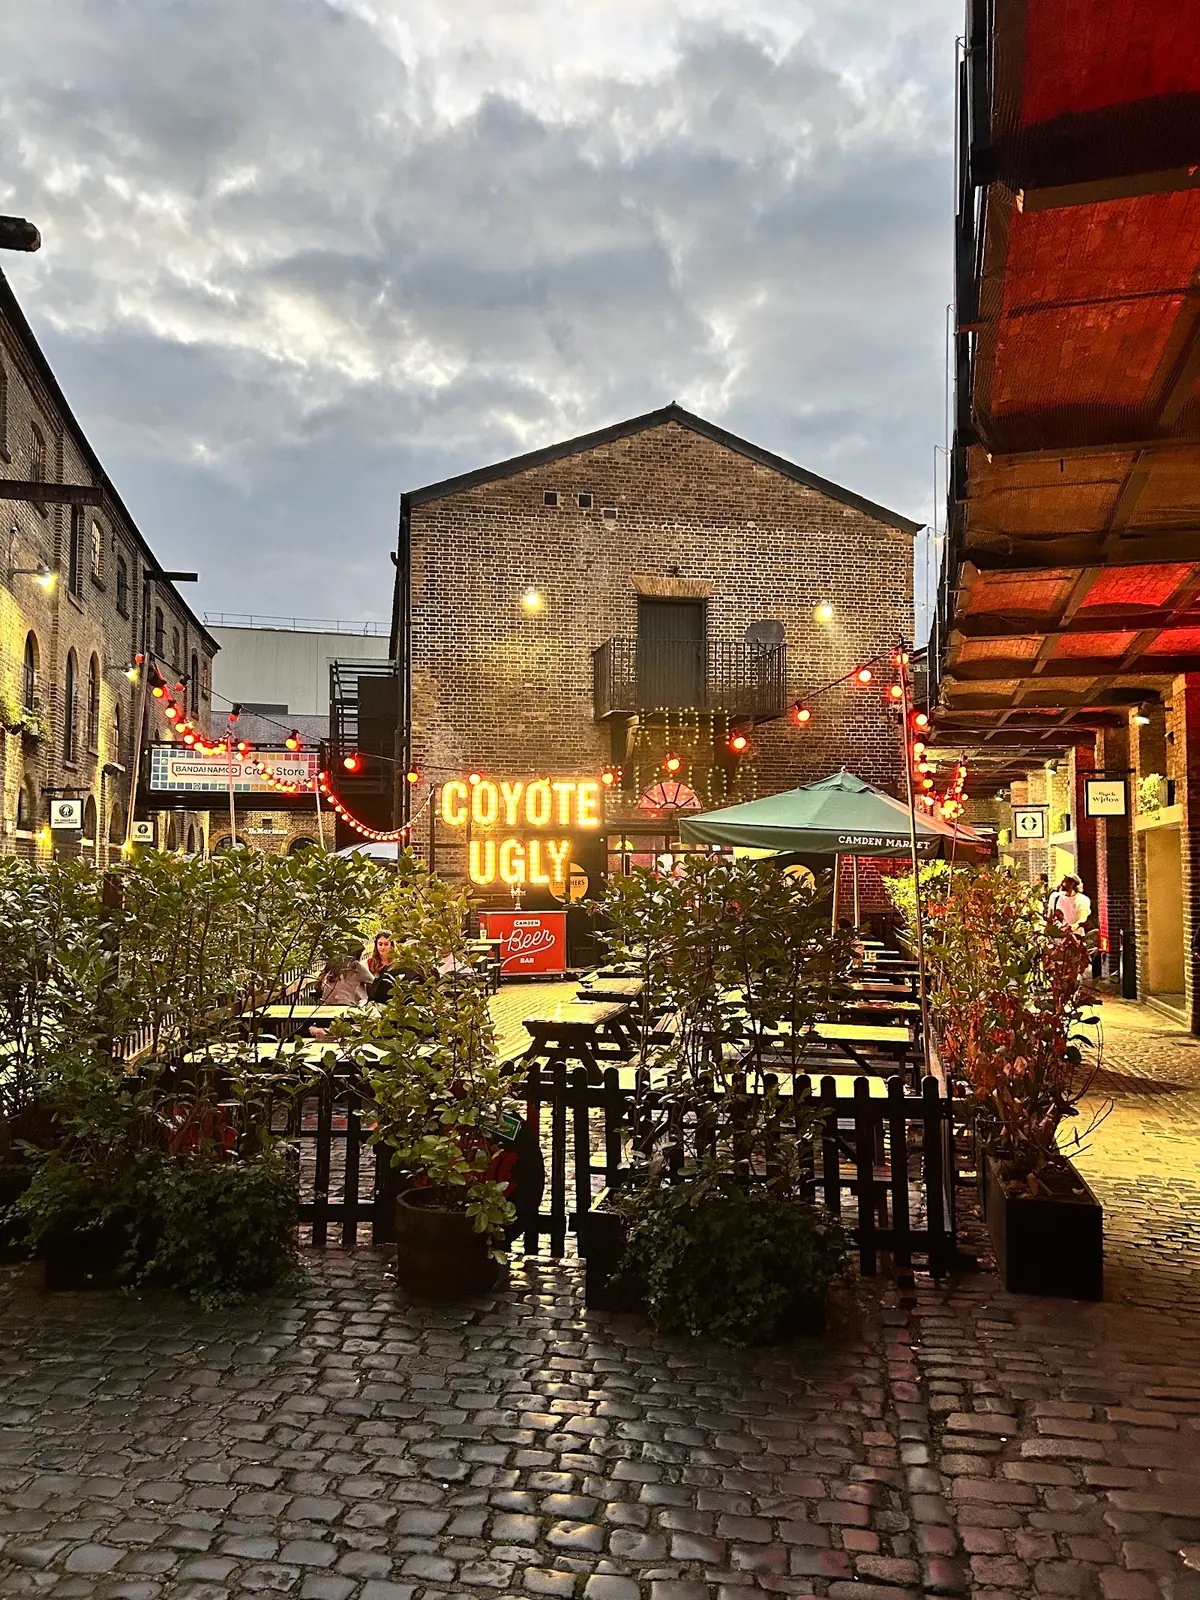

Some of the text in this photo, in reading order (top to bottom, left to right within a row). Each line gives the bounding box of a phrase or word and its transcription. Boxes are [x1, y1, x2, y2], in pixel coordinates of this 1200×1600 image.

[276, 766, 305, 776] Store
[441, 780, 600, 826] COYOTE
[837, 835, 883, 846] CAMDEN
[468, 838, 571, 885] UGLY
[500, 929, 555, 952] Beer
